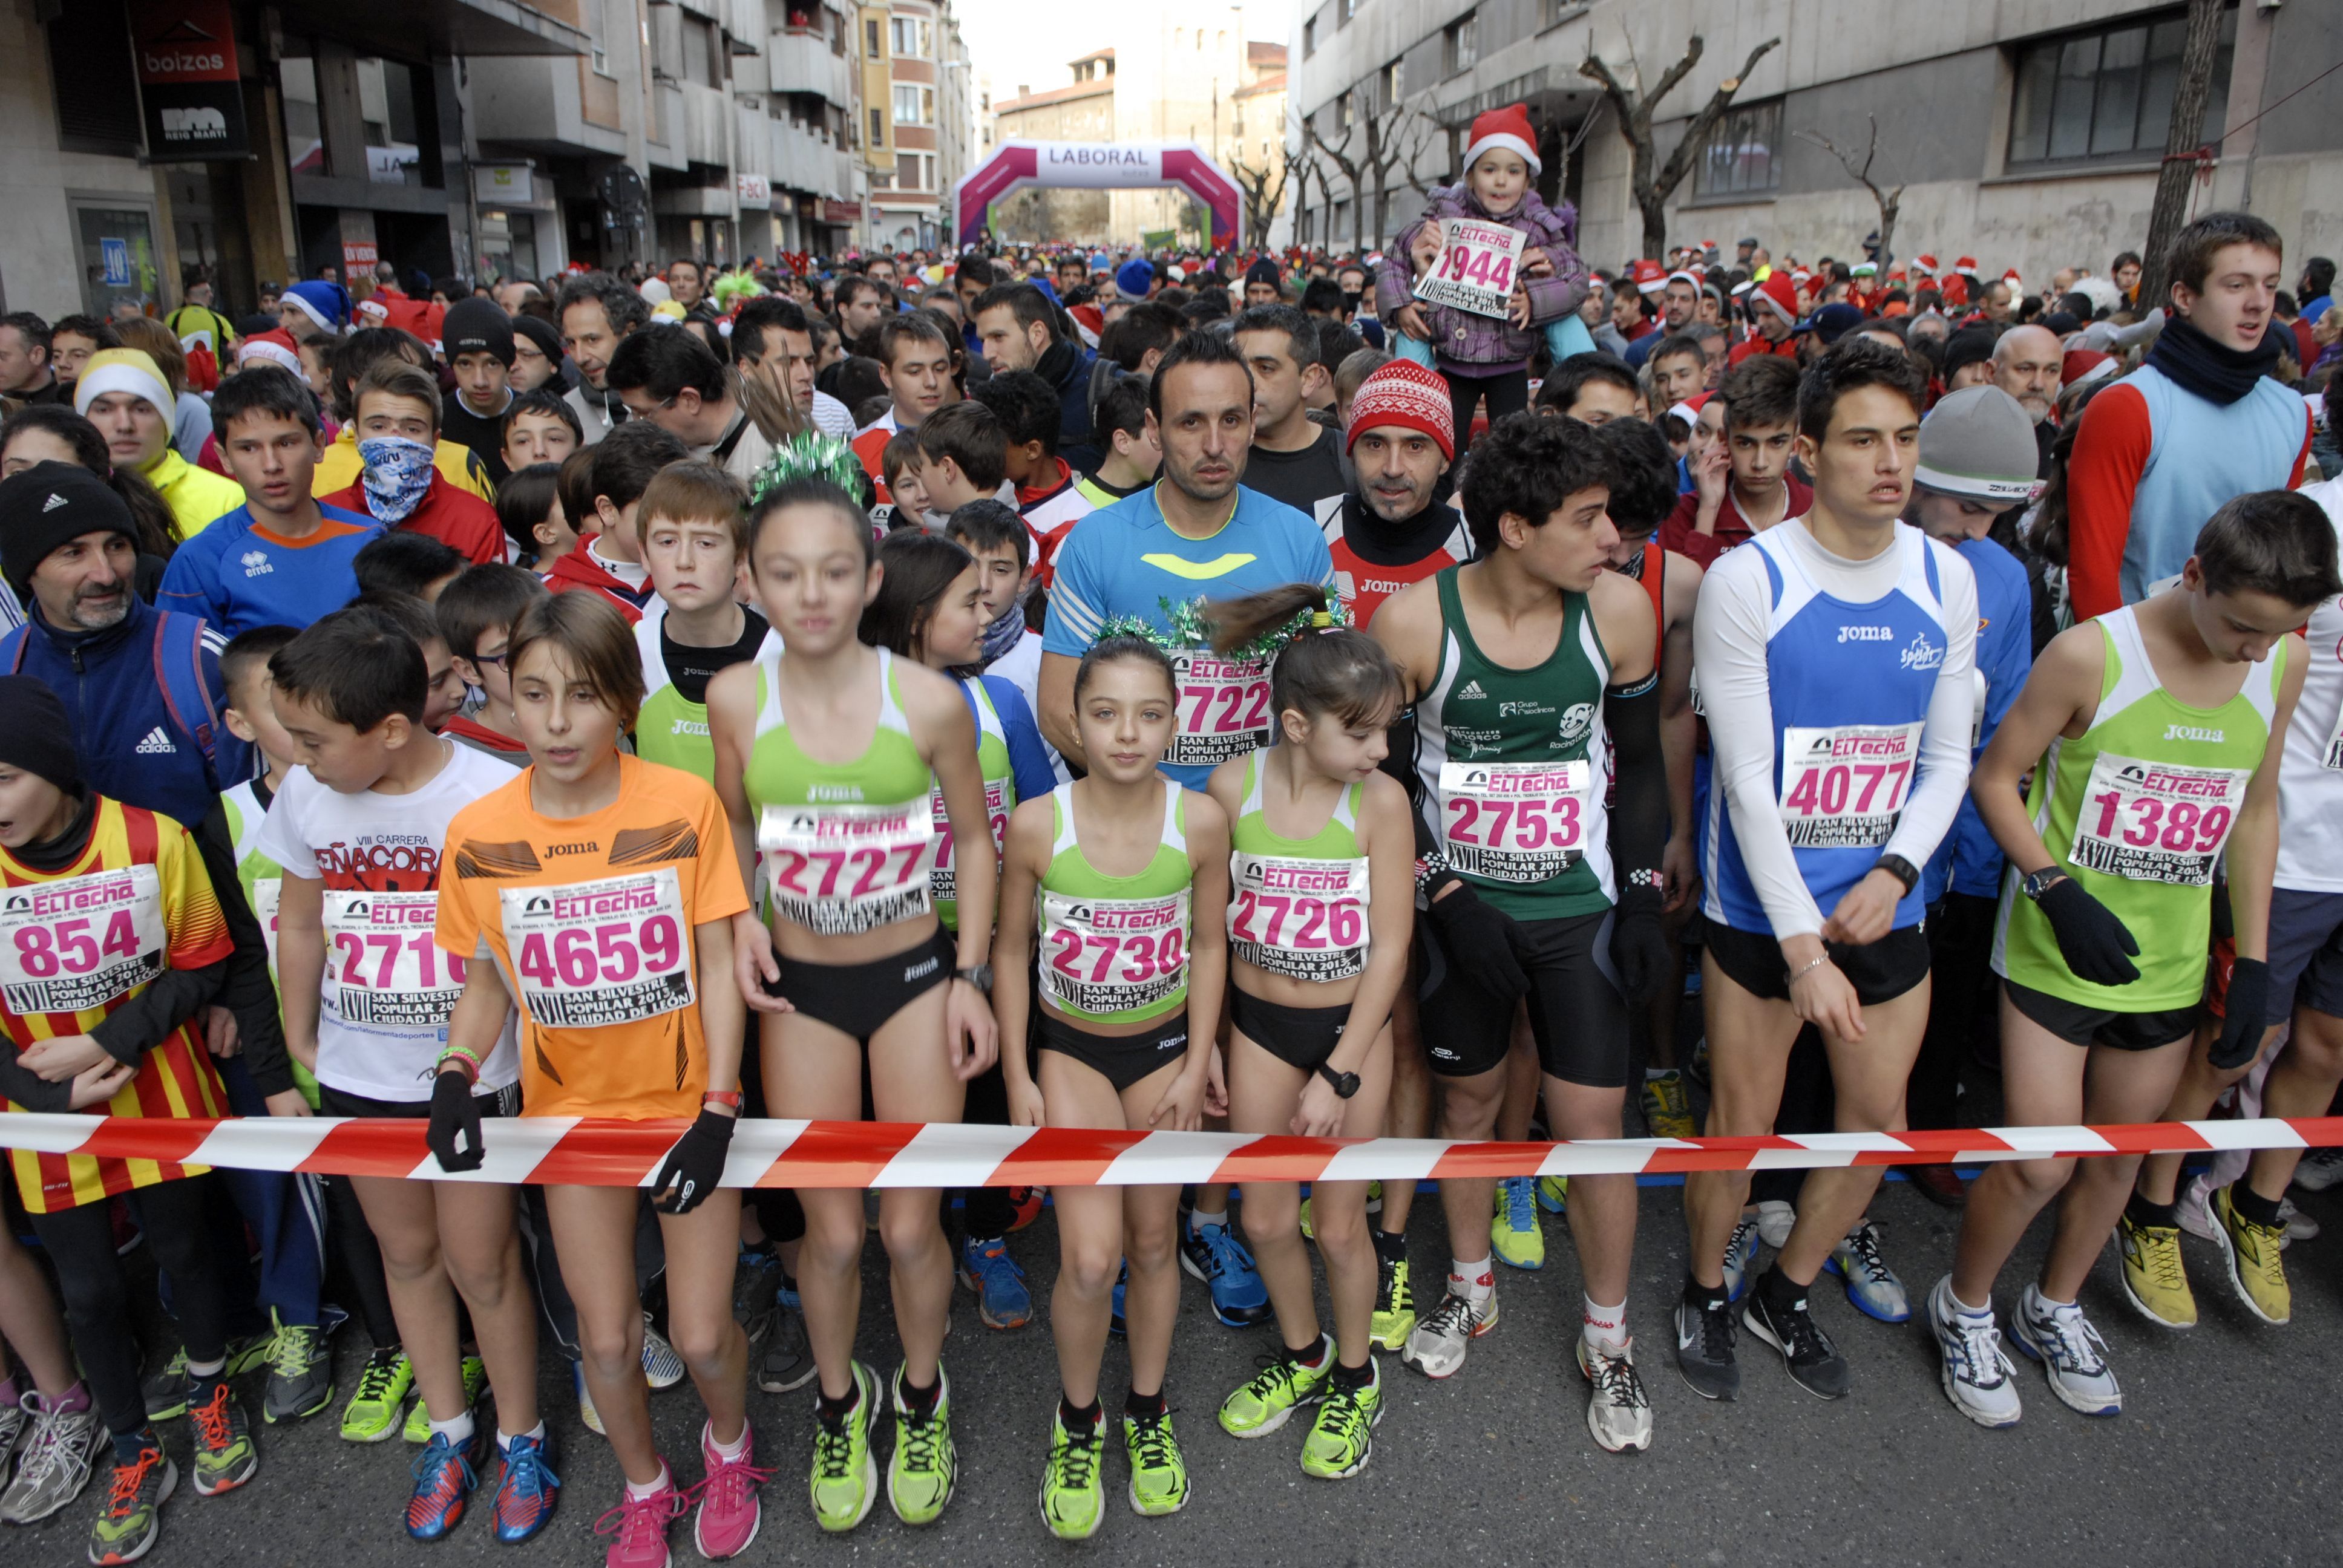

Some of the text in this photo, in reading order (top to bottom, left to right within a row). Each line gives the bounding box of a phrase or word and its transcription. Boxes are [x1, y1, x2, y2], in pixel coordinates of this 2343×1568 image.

[145, 51, 224, 72] boizas
[1049, 148, 1149, 165] LABORAL
[1438, 244, 1512, 292] 1944
[1438, 295, 1469, 307] CIUDAD
[1470, 303, 1482, 312] DE
[1440, 289, 1475, 301] POPULAR
[42, 498, 68, 512] adidas
[672, 719, 710, 736] Jom
[1208, 731, 1256, 745] SILVESTRE
[1550, 728, 1592, 750] Racing León
[136, 743, 177, 754] adidas
[1180, 745, 1231, 754] POPULAR
[1180, 754, 1224, 763] CIUDAD
[1787, 760, 1911, 815] 4077
[1448, 797, 1580, 849] 2753
[1815, 819, 1838, 828] SAN
[2094, 791, 2231, 852] 1389
[356, 835, 428, 846] VIII CARRERA
[1810, 837, 1858, 846] CIUDAD
[1860, 836, 1875, 845] DE
[1812, 828, 1866, 837] POPULAR
[1449, 843, 1480, 872] XVII
[1481, 849, 1567, 861] SAN SILVESTRE
[2077, 837, 2113, 872] XVII
[2117, 848, 2144, 860] SAN
[774, 842, 927, 898] 2727
[1481, 858, 1536, 871] POPULAR
[2115, 857, 2172, 872] POPULAR
[1481, 867, 1528, 880] CIUDAD
[1531, 871, 1545, 880] DE
[2112, 866, 2161, 878] CIUDAD
[2163, 871, 2181, 882] DE
[371, 903, 436, 924] ElTec
[1233, 890, 1361, 948] 2726
[13, 909, 140, 977] 854
[520, 915, 680, 988] 4659
[1050, 927, 1184, 982] 2730
[1260, 946, 1347, 962] SAN SILVESTRE
[1260, 955, 1315, 971] POPULAR
[47, 956, 145, 990] SAN SILVESTRE
[1311, 971, 1328, 981] DE
[1331, 963, 1361, 978] LEÓN
[50, 978, 114, 999] POPULAR
[563, 976, 667, 1004] SAN SILVESTRE
[1054, 972, 1081, 1008] XVII
[1083, 975, 1171, 995] SAN SILVESTRE
[8, 981, 52, 1012] XVII
[53, 991, 108, 1010] CIUDAD
[111, 984, 125, 996] DE
[341, 988, 373, 1022] XVII
[372, 989, 464, 1004] SAN SILVESTR
[1083, 993, 1141, 1003] POPULAR
[1083, 1002, 1133, 1012] CIUDAD
[1136, 997, 1150, 1007] DE
[372, 1004, 433, 1014] POPULAR
[566, 998, 634, 1015] POPULAR
[568, 992, 689, 1025] CIUDAD DE LEÓN
[372, 1013, 448, 1024] CIUDAD DE
